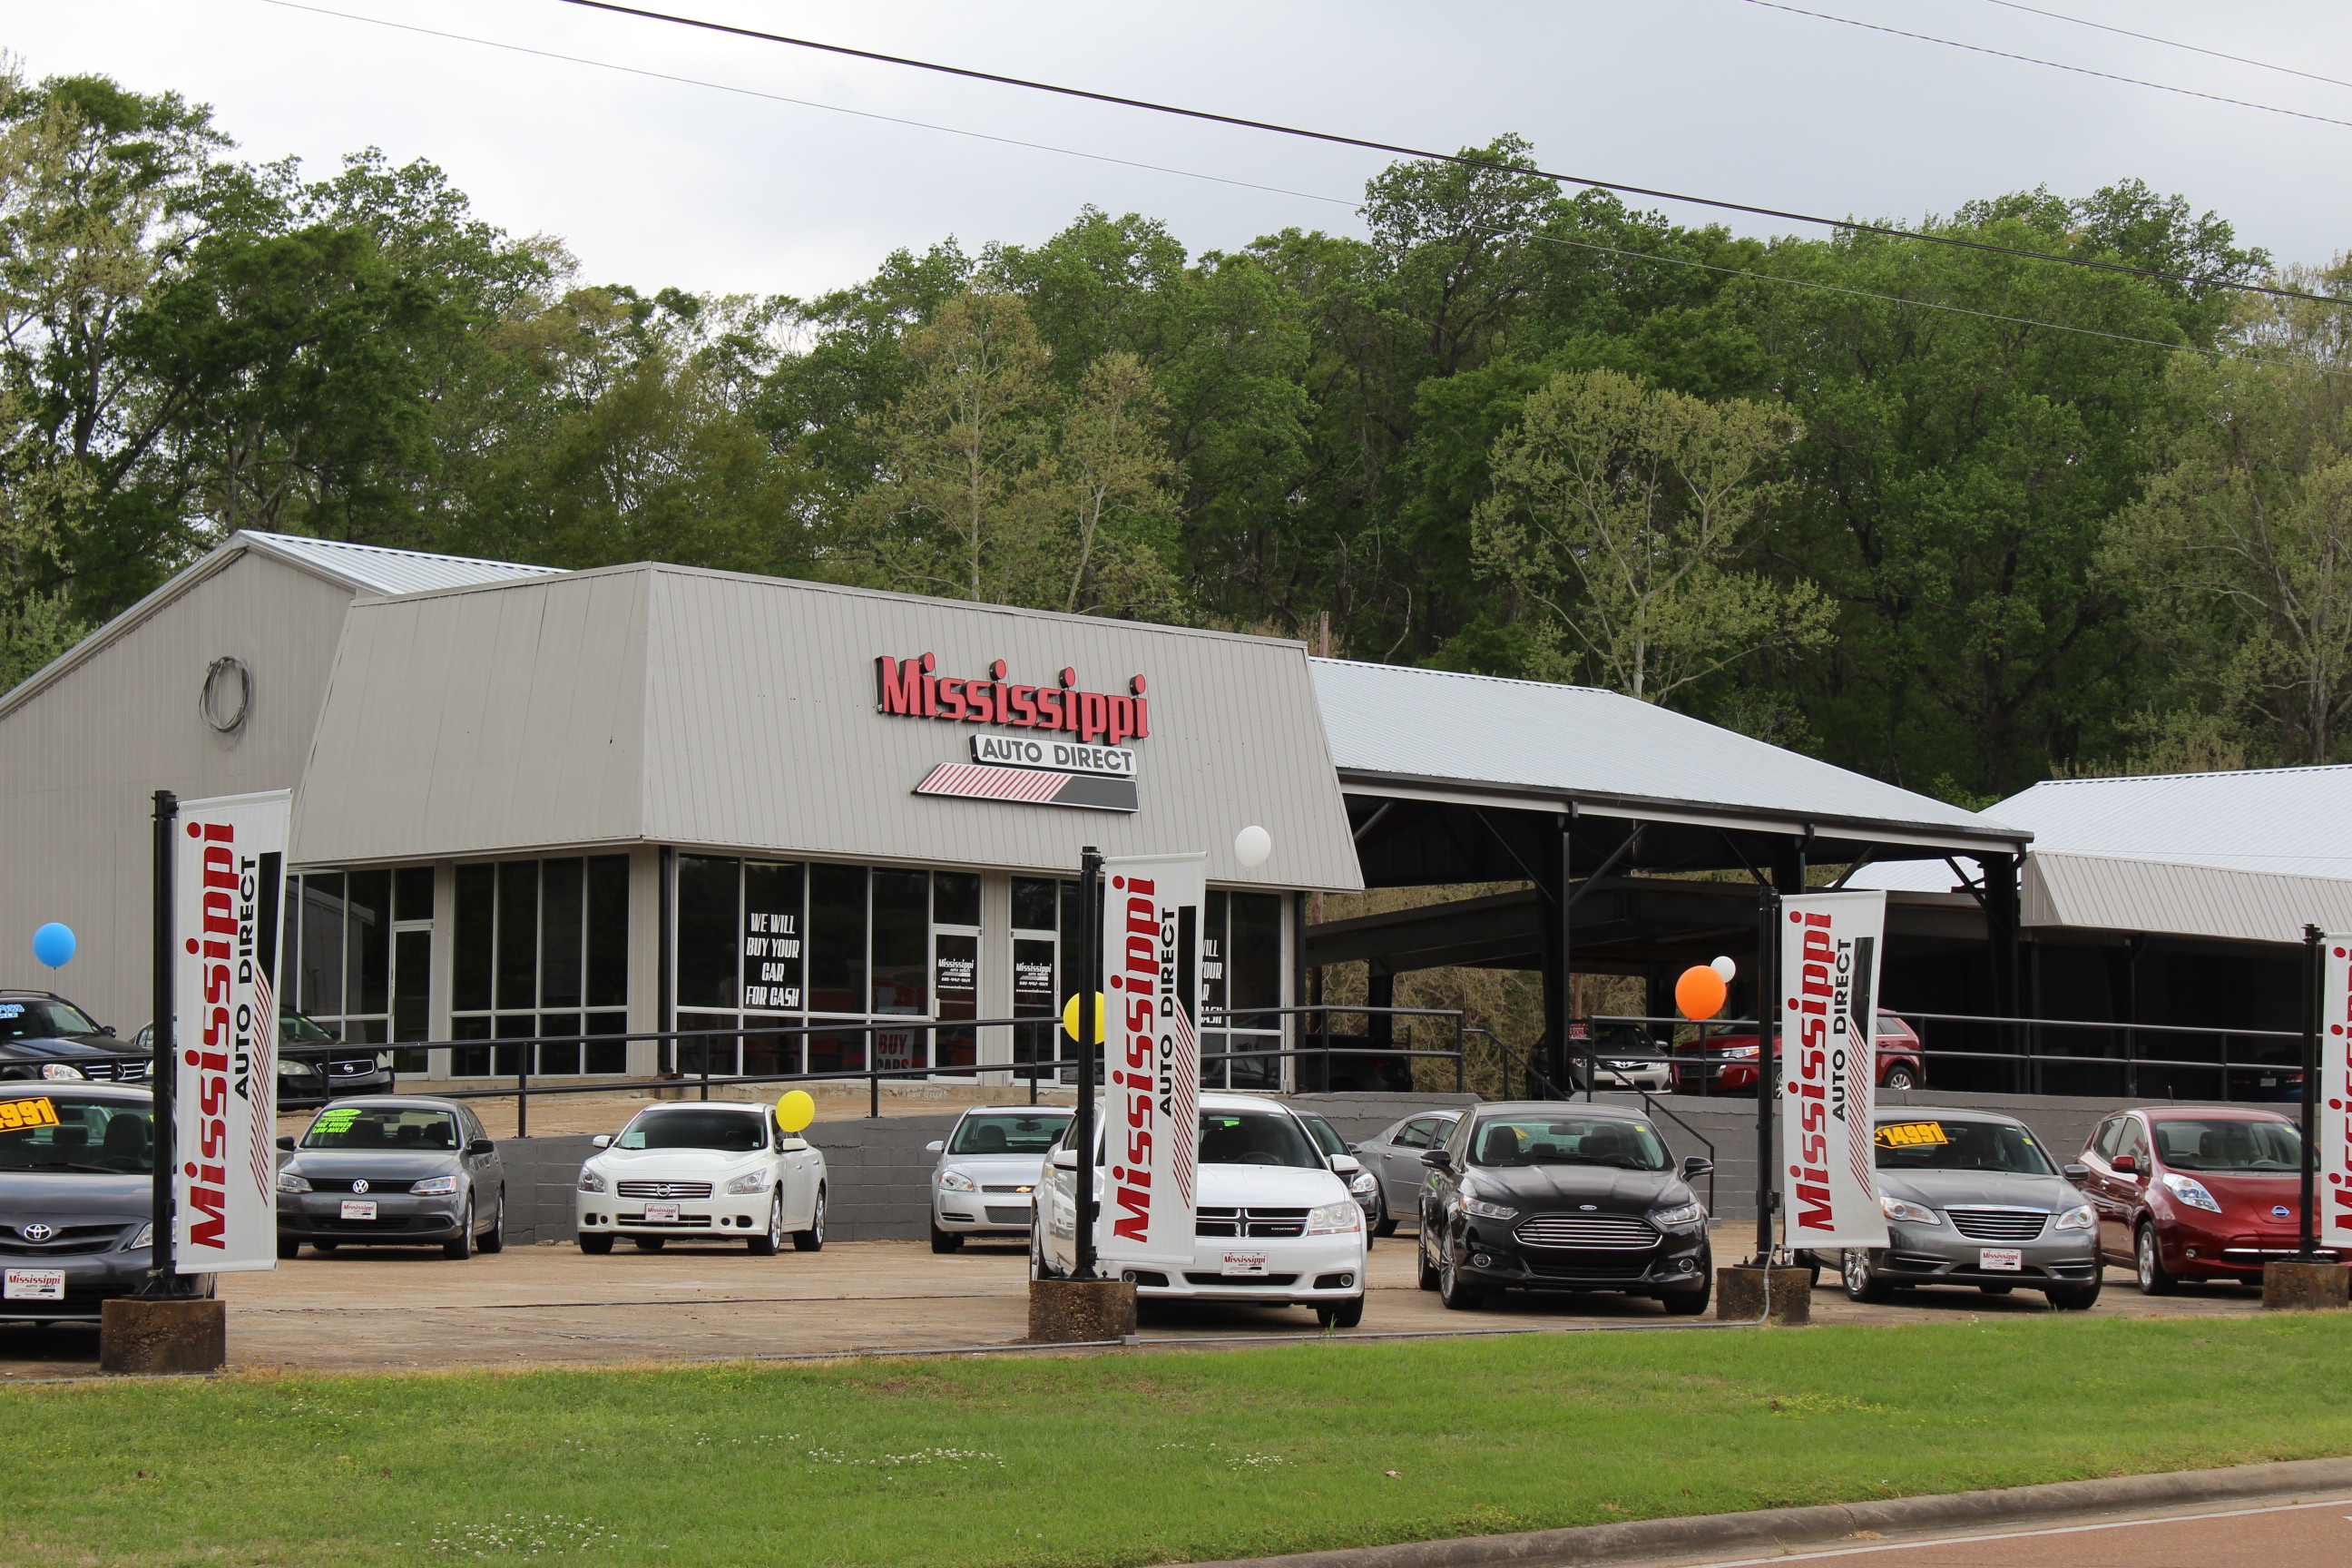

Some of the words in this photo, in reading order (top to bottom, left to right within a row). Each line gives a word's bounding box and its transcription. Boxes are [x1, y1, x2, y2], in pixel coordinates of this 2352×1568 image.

[876, 652, 1150, 744] Mississippi
[983, 739, 1042, 763] AUTO
[1054, 745, 1132, 771] DIRECT
[239, 855, 256, 985] DIRECT
[750, 913, 769, 932] WE
[770, 914, 795, 934] WILL
[746, 936, 769, 957] BUY
[771, 938, 799, 958] YOUR
[1203, 939, 1219, 956] ILL
[761, 962, 785, 982] CAR
[938, 958, 974, 969] Mississippi
[1016, 962, 1051, 973] Mississippi
[1161, 907, 1175, 1017] DIRECT
[1202, 962, 1222, 979] OUR
[746, 985, 768, 1005] FOR
[769, 986, 799, 1006] CASH
[1834, 938, 1851, 1034] DIRECT
[184, 821, 239, 1250] Mississippi
[878, 1034, 908, 1054] BUY
[235, 1004, 251, 1102] AUTO
[1111, 875, 1160, 1242] Mississippi
[1160, 1034, 1172, 1118] AUTO
[1788, 910, 1835, 1232] Mississippi
[1832, 1049, 1846, 1122] AUTO
[0, 1099, 54, 1129] 991
[1224, 1255, 1266, 1264] Mississippi
[1983, 1252, 2019, 1260] Mississippi
[8, 1274, 61, 1285] Mississippi
